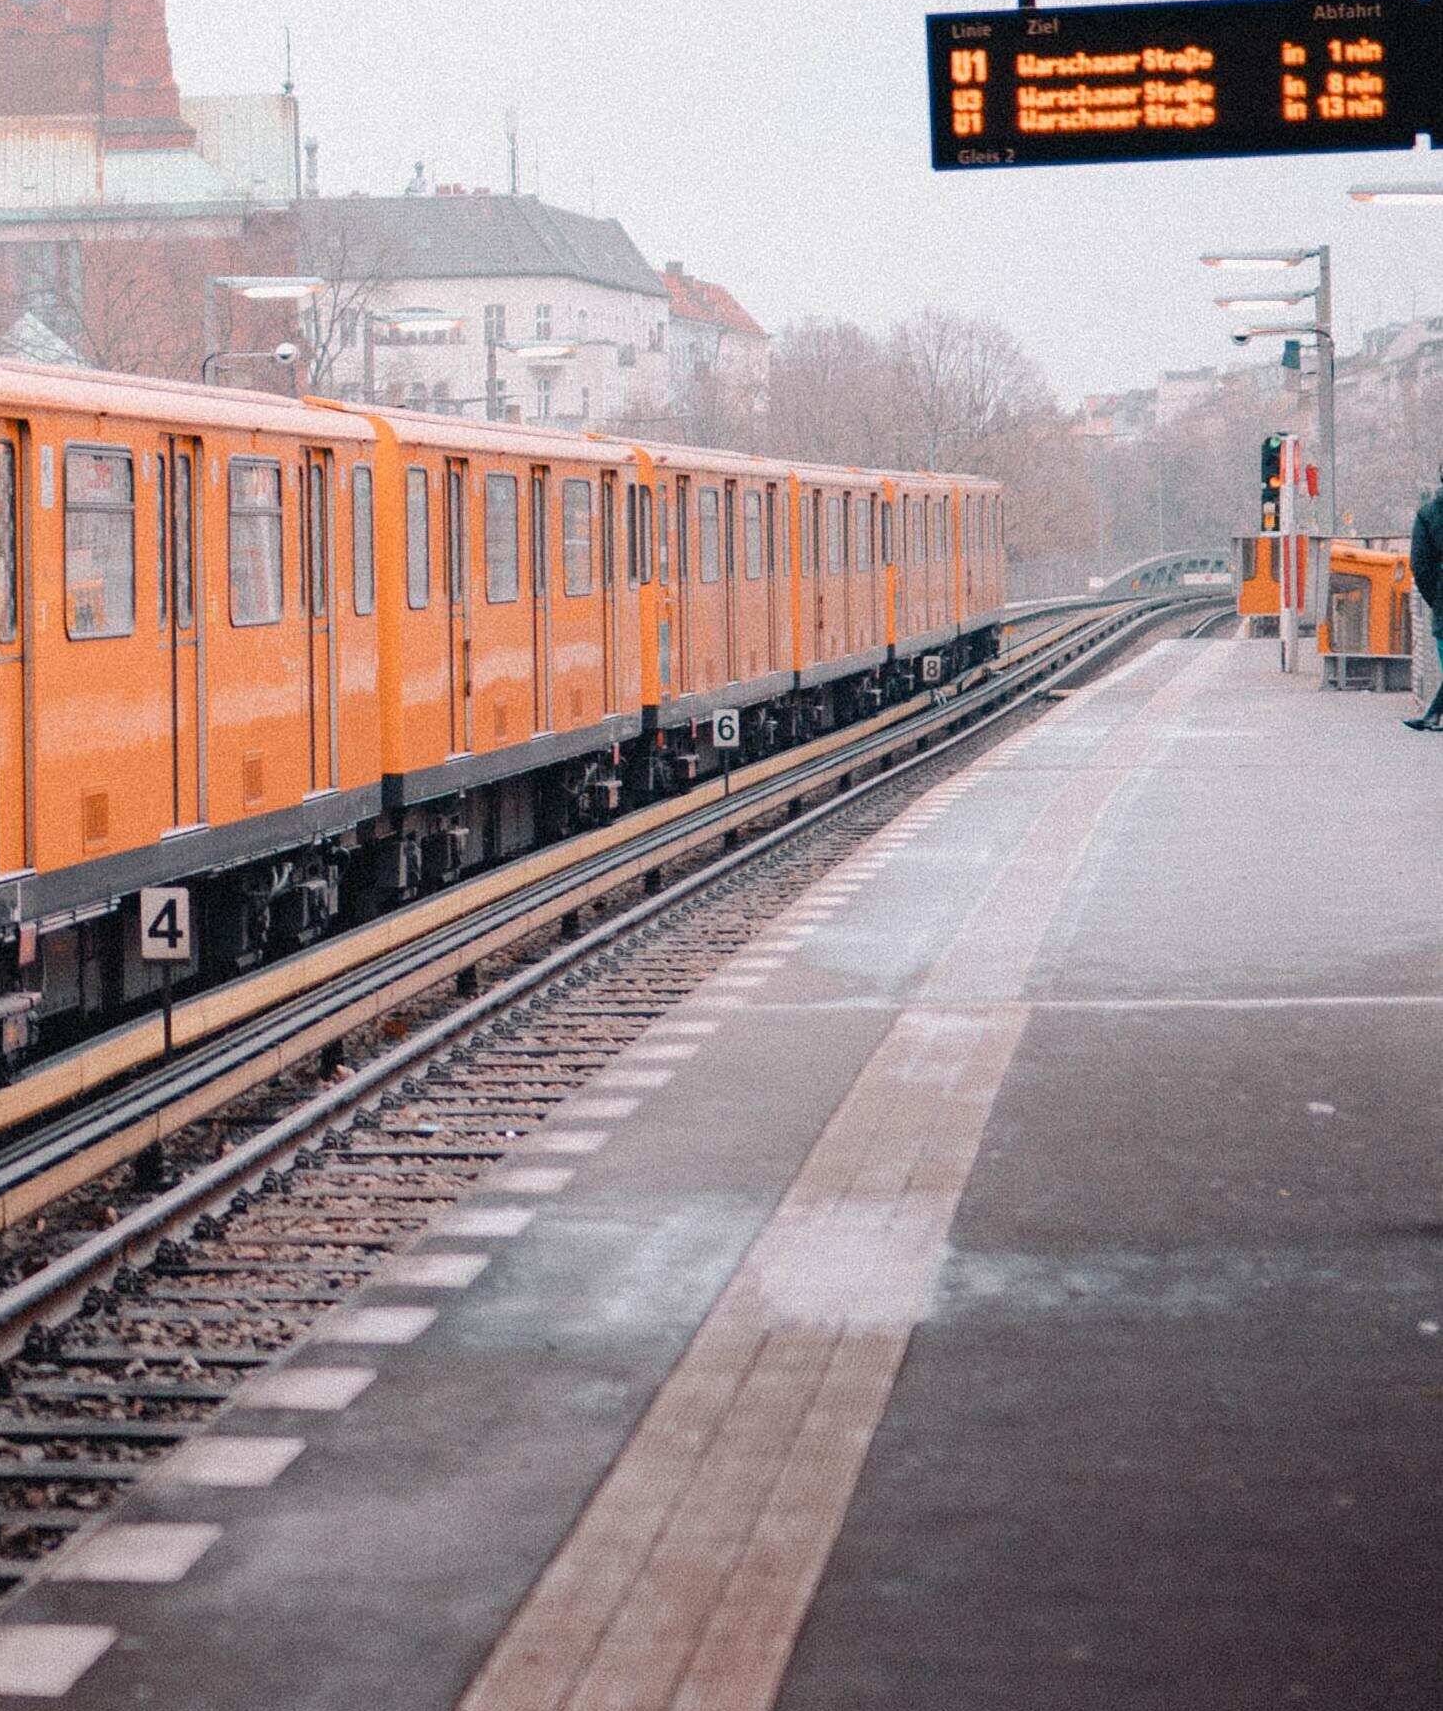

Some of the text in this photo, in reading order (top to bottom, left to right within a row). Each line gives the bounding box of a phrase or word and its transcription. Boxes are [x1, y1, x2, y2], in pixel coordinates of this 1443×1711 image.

[1313, 3, 1383, 21] Abfahrt
[951, 23, 992, 39] Linie
[1026, 18, 1060, 35] Ziel
[950, 49, 988, 83] U1
[1142, 46, 1215, 73] Straße
[1281, 41, 1307, 66] in
[1328, 39, 1343, 63] 1
[1344, 37, 1385, 63] min
[1282, 74, 1307, 97] in
[1345, 71, 1385, 95] min
[1283, 98, 1308, 122] in
[1345, 95, 1385, 119] min
[957, 149, 1015, 165] Gleis 2
[925, 659, 938, 677] 8
[718, 715, 735, 742] 6
[148, 898, 184, 949] 4
